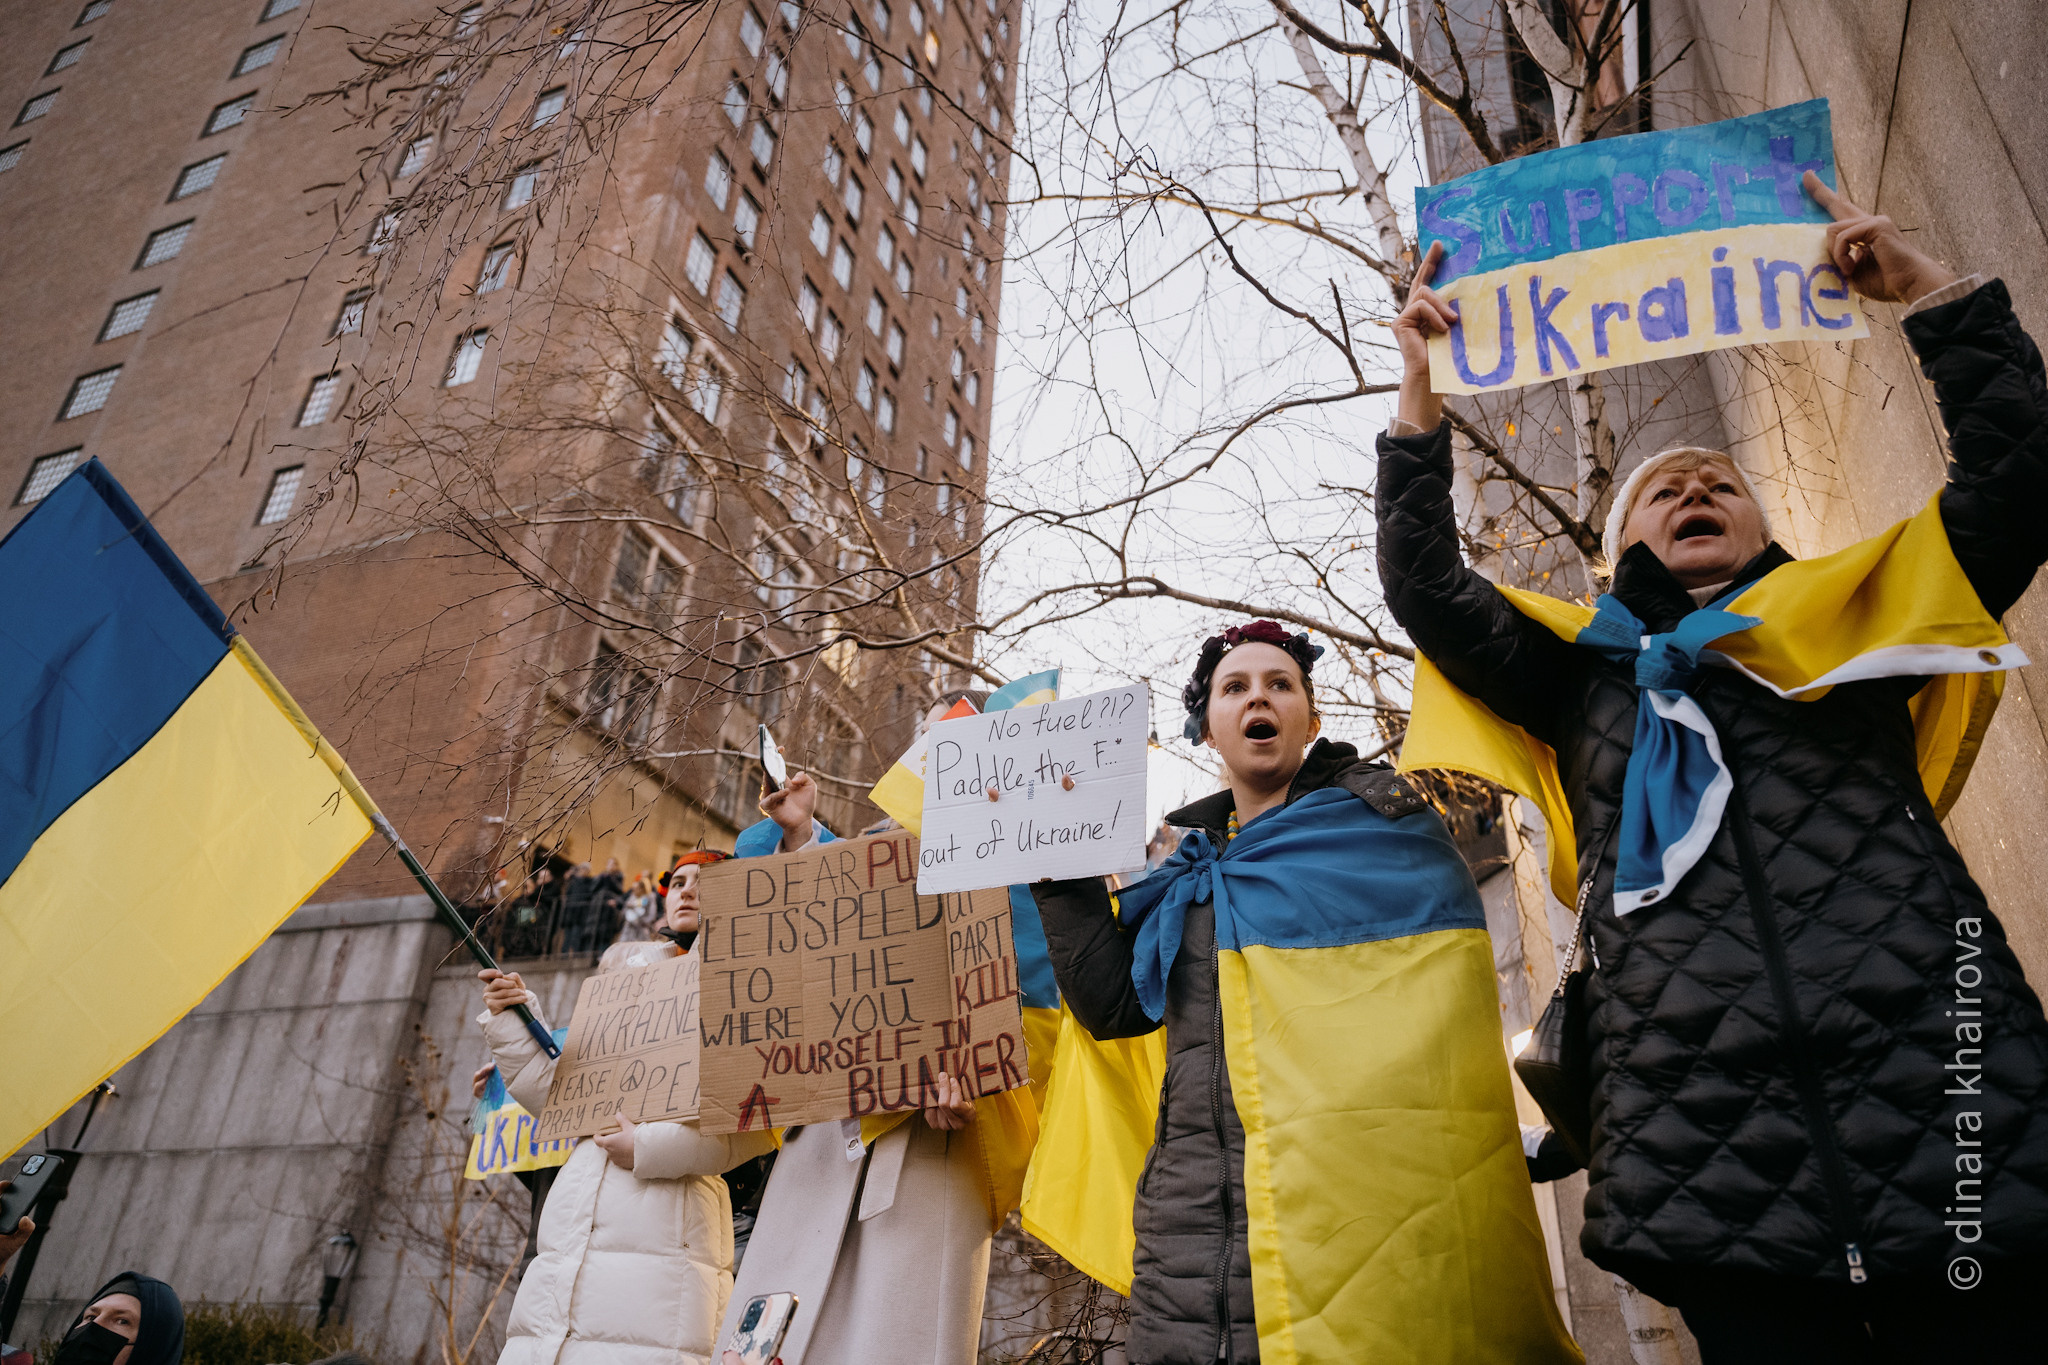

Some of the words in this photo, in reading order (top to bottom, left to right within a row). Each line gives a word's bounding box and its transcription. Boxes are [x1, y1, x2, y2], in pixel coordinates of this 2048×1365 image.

[1421, 135, 1826, 284] Support
[1448, 246, 1854, 387] Ukraine
[988, 710, 1021, 742] No
[936, 740, 1026, 800] Paddle
[1034, 749, 1086, 784] the
[921, 833, 961, 868] out
[976, 819, 1005, 859] of
[1017, 800, 1122, 852] Ukraine!
[746, 850, 861, 908] DEAR
[867, 838, 918, 890] PU
[586, 967, 661, 1009] PLEASE
[671, 960, 699, 990] PR
[715, 967, 773, 1009] TO
[816, 944, 914, 998] THE
[949, 911, 1008, 975] PART
[577, 990, 700, 1061] UKRAINE
[700, 1005, 803, 1048] WHERE
[829, 988, 925, 1038] YOU
[955, 955, 1019, 1017] KILL
[737, 1082, 781, 1132] A
[848, 1031, 1024, 1118] BUNKER
[755, 1024, 923, 1080] YOURSELF
[932, 1015, 972, 1053] IN
[537, 1103, 587, 1140] PRAY
[591, 1096, 625, 1120] FOR
[638, 1061, 700, 1117] PE
[545, 1069, 612, 1108] PLEASE
